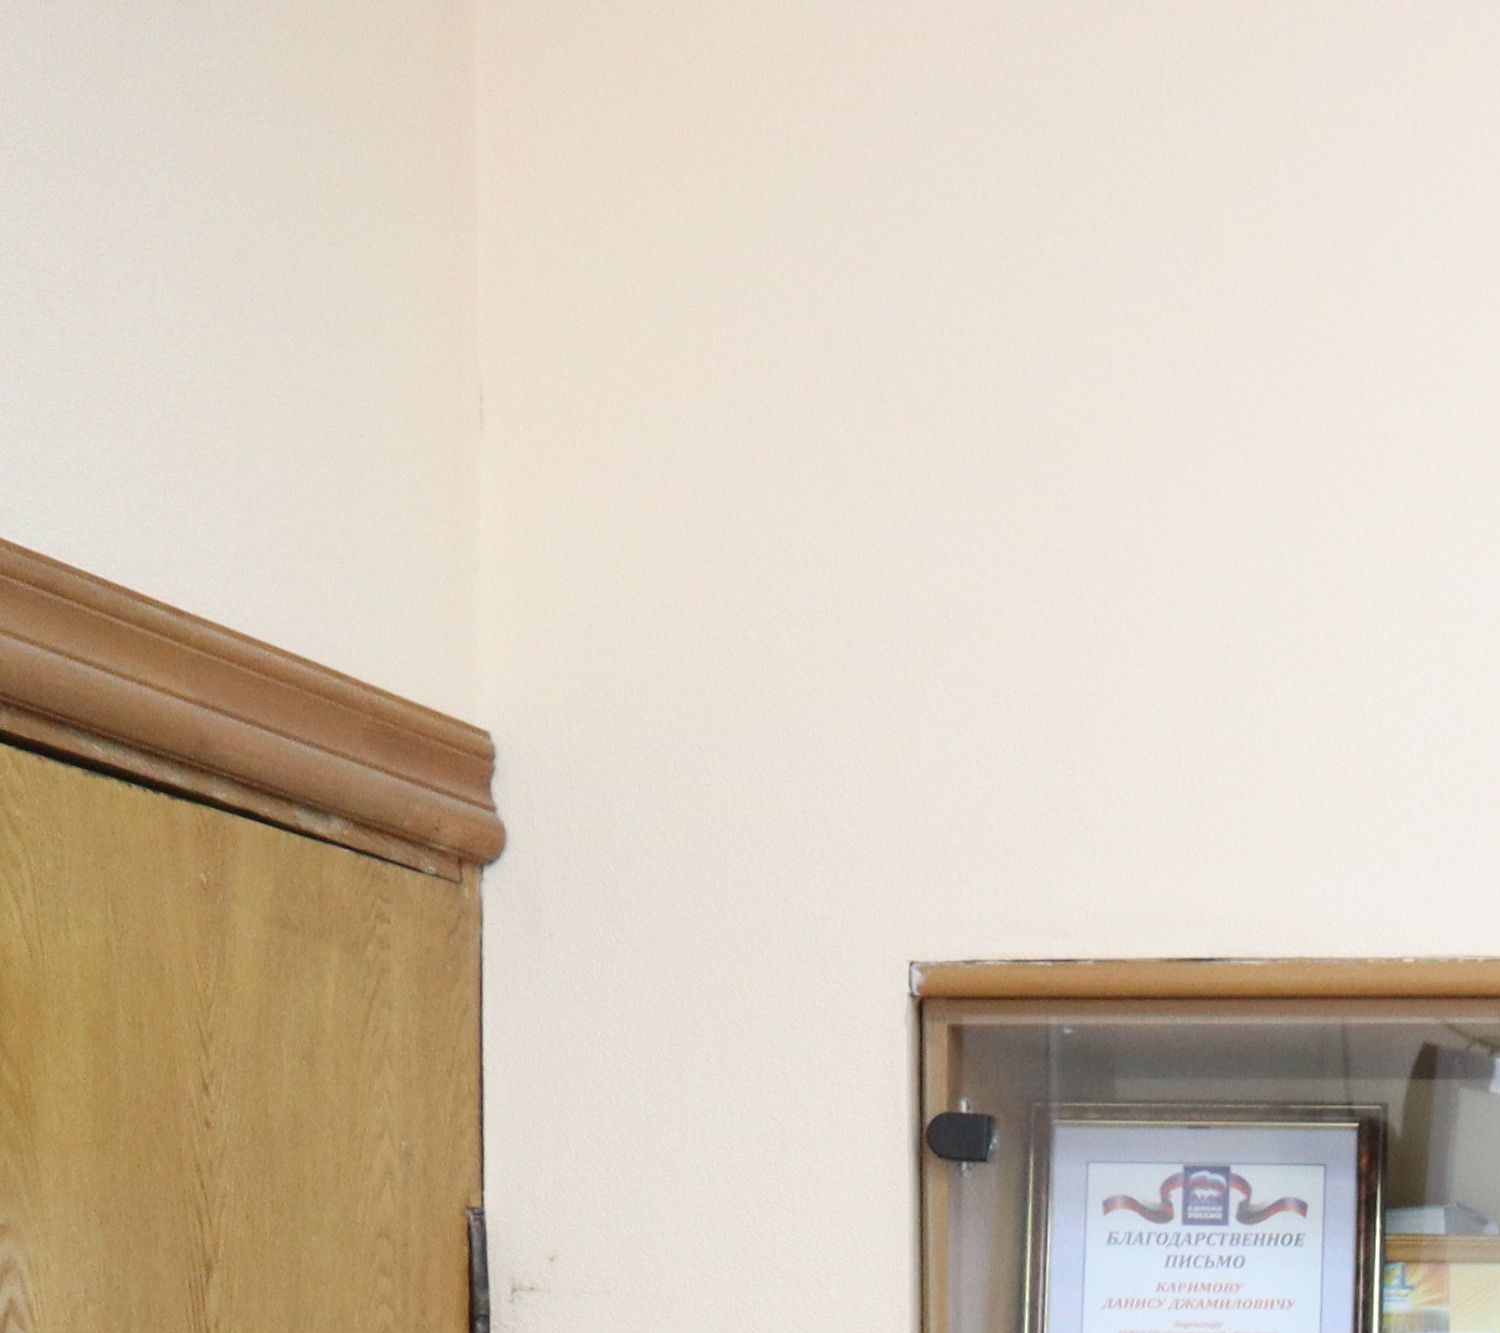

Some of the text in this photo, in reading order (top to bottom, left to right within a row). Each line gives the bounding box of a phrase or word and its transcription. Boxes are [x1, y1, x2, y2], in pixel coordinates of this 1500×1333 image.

[1105, 1231, 1306, 1249] БЛАГОДАРСТВЕННОЕ
[1164, 1254, 1247, 1270] ПИСЬМО
[1155, 1282, 1245, 1294] КАРИМОВУ
[1101, 1298, 1297, 1311] ДАНИСУ ДЖАМИЛОВИЧУ
